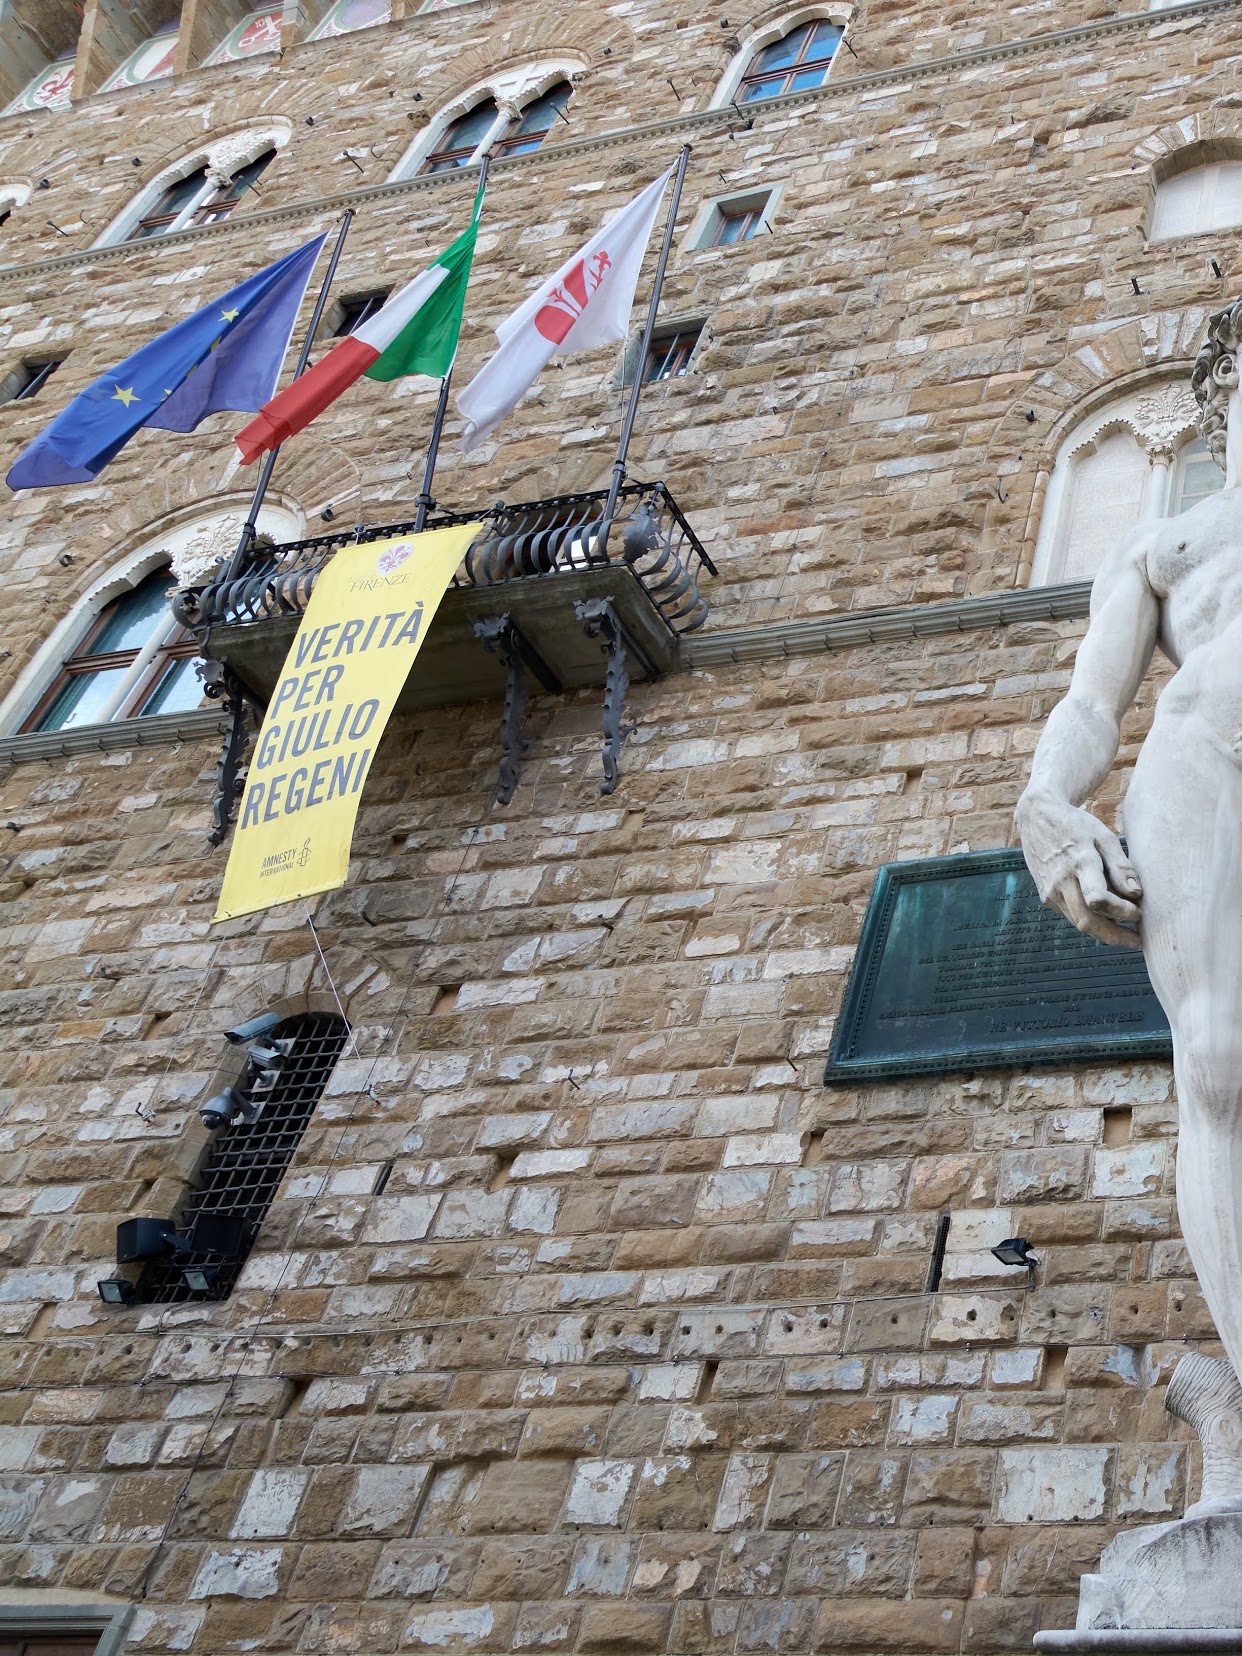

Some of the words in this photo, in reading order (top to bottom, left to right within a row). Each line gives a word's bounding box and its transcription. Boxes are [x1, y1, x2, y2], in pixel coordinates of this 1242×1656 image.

[350, 573, 411, 592] FIRENZE
[294, 601, 424, 669] VERITÀ
[270, 664, 345, 720] PER
[256, 699, 380, 770] GIULIO
[240, 749, 371, 830] REGENI
[262, 848, 297, 869] AMNESTY
[1014, 1015, 1069, 1031] VITTORIO
[1073, 1009, 1145, 1026] EMANUELE
